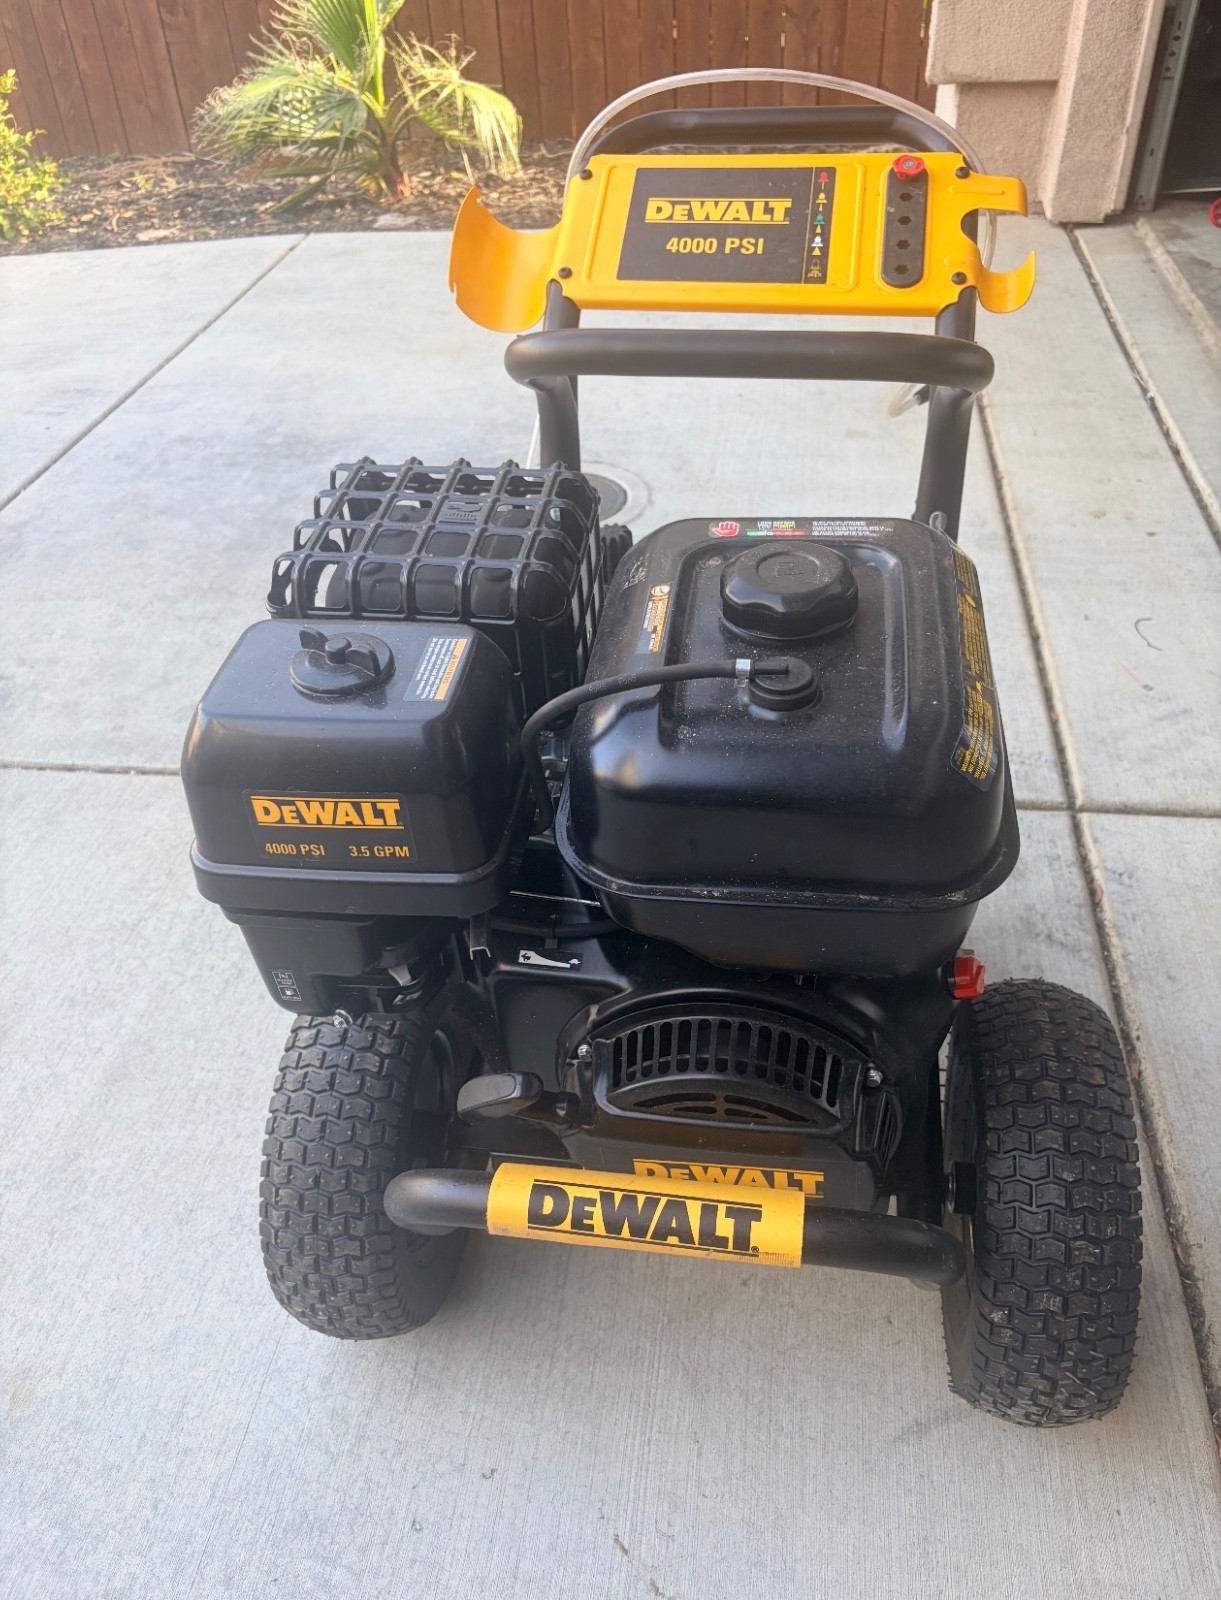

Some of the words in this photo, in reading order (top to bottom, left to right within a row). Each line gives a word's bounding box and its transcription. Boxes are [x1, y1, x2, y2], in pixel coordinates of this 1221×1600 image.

[665, 237, 718, 254] 4000
[724, 237, 764, 255] PSI
[265, 843, 297, 855] 4000
[300, 844, 326, 856] PSI
[349, 845, 370, 858] 3.5
[374, 846, 410, 858] GPM
